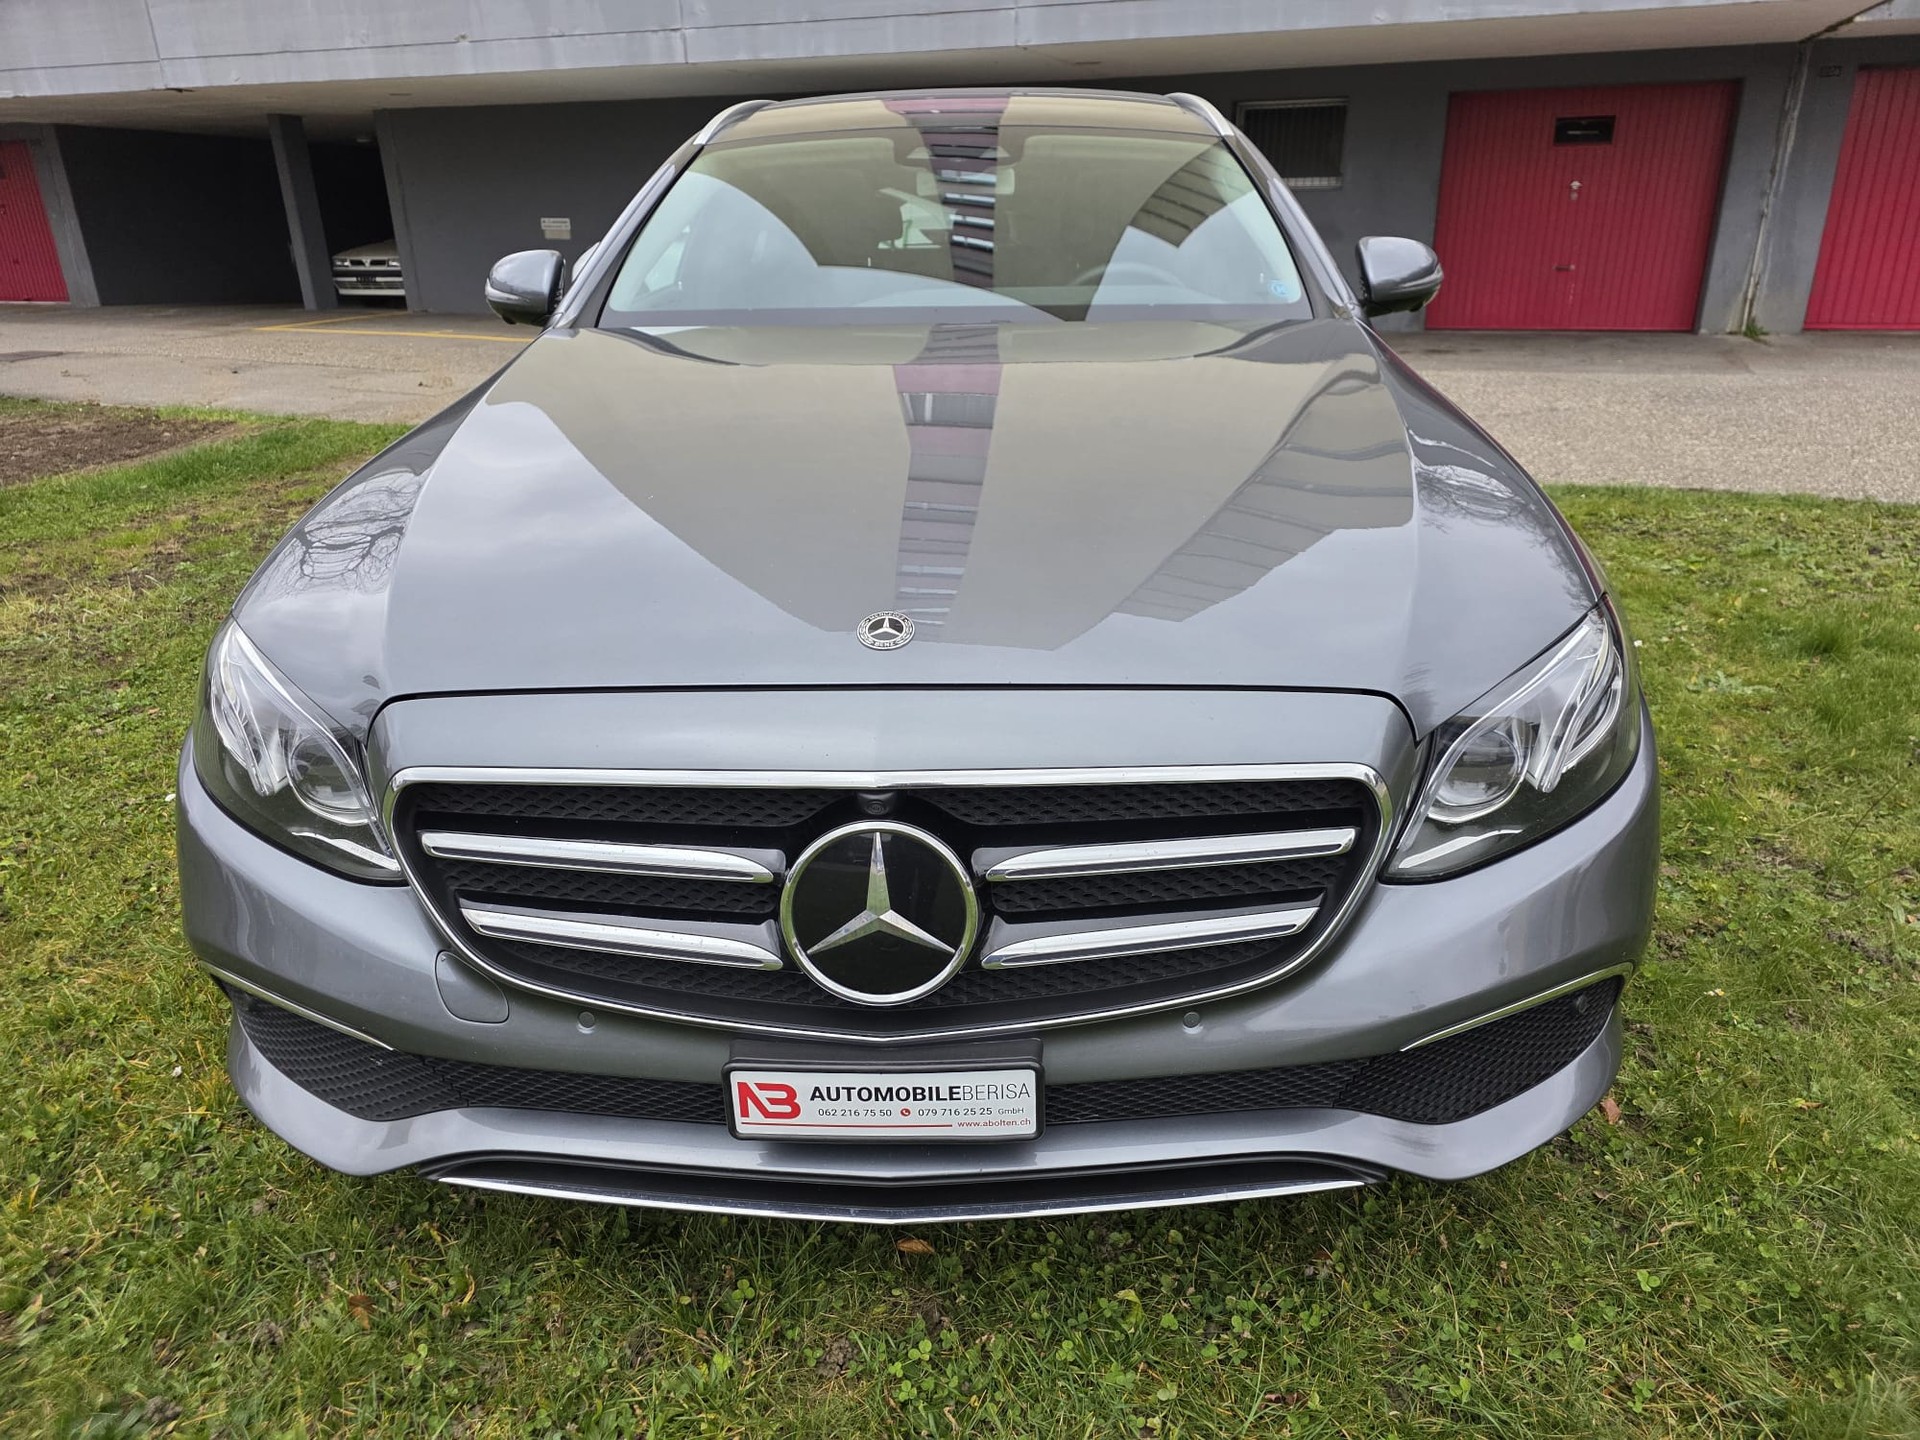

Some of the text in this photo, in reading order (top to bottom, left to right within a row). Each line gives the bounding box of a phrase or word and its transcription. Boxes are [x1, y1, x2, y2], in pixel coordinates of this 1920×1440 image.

[818, 1108, 893, 1118] 062 216 75 50
[918, 1107, 1025, 1117] 079 716 25 25 GmbH
[957, 1118, 1031, 1128] www.abolten.ch
